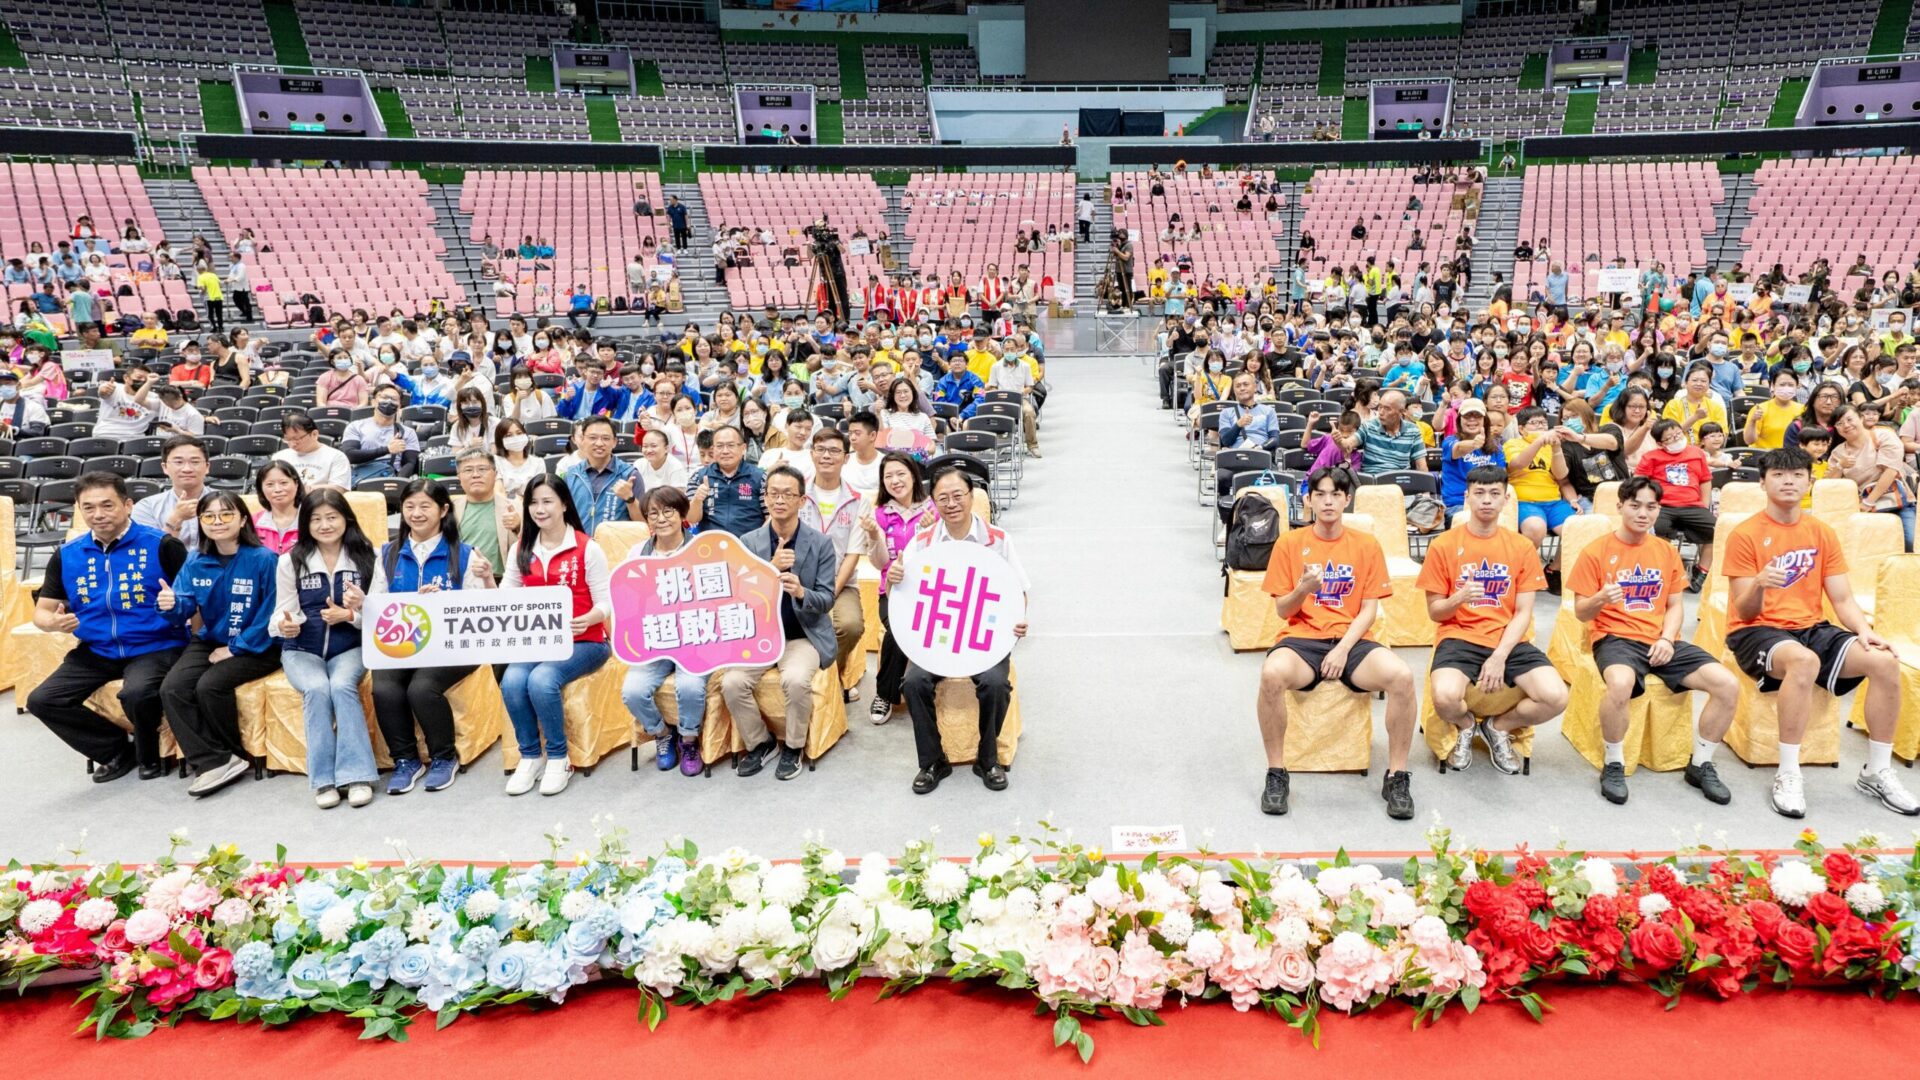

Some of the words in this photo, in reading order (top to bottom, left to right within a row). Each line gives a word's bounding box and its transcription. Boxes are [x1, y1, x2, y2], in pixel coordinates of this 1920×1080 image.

[192, 577, 213, 587] tao
[655, 561, 733, 606] 桃園
[444, 605, 507, 615] DEPARTMENT
[512, 603, 523, 611] OF
[527, 602, 562, 610] SPORTS
[444, 613, 562, 635] TAOYUAN
[641, 602, 757, 651] 超敢動
[444, 635, 563, 649] 桃園市政府體育局
